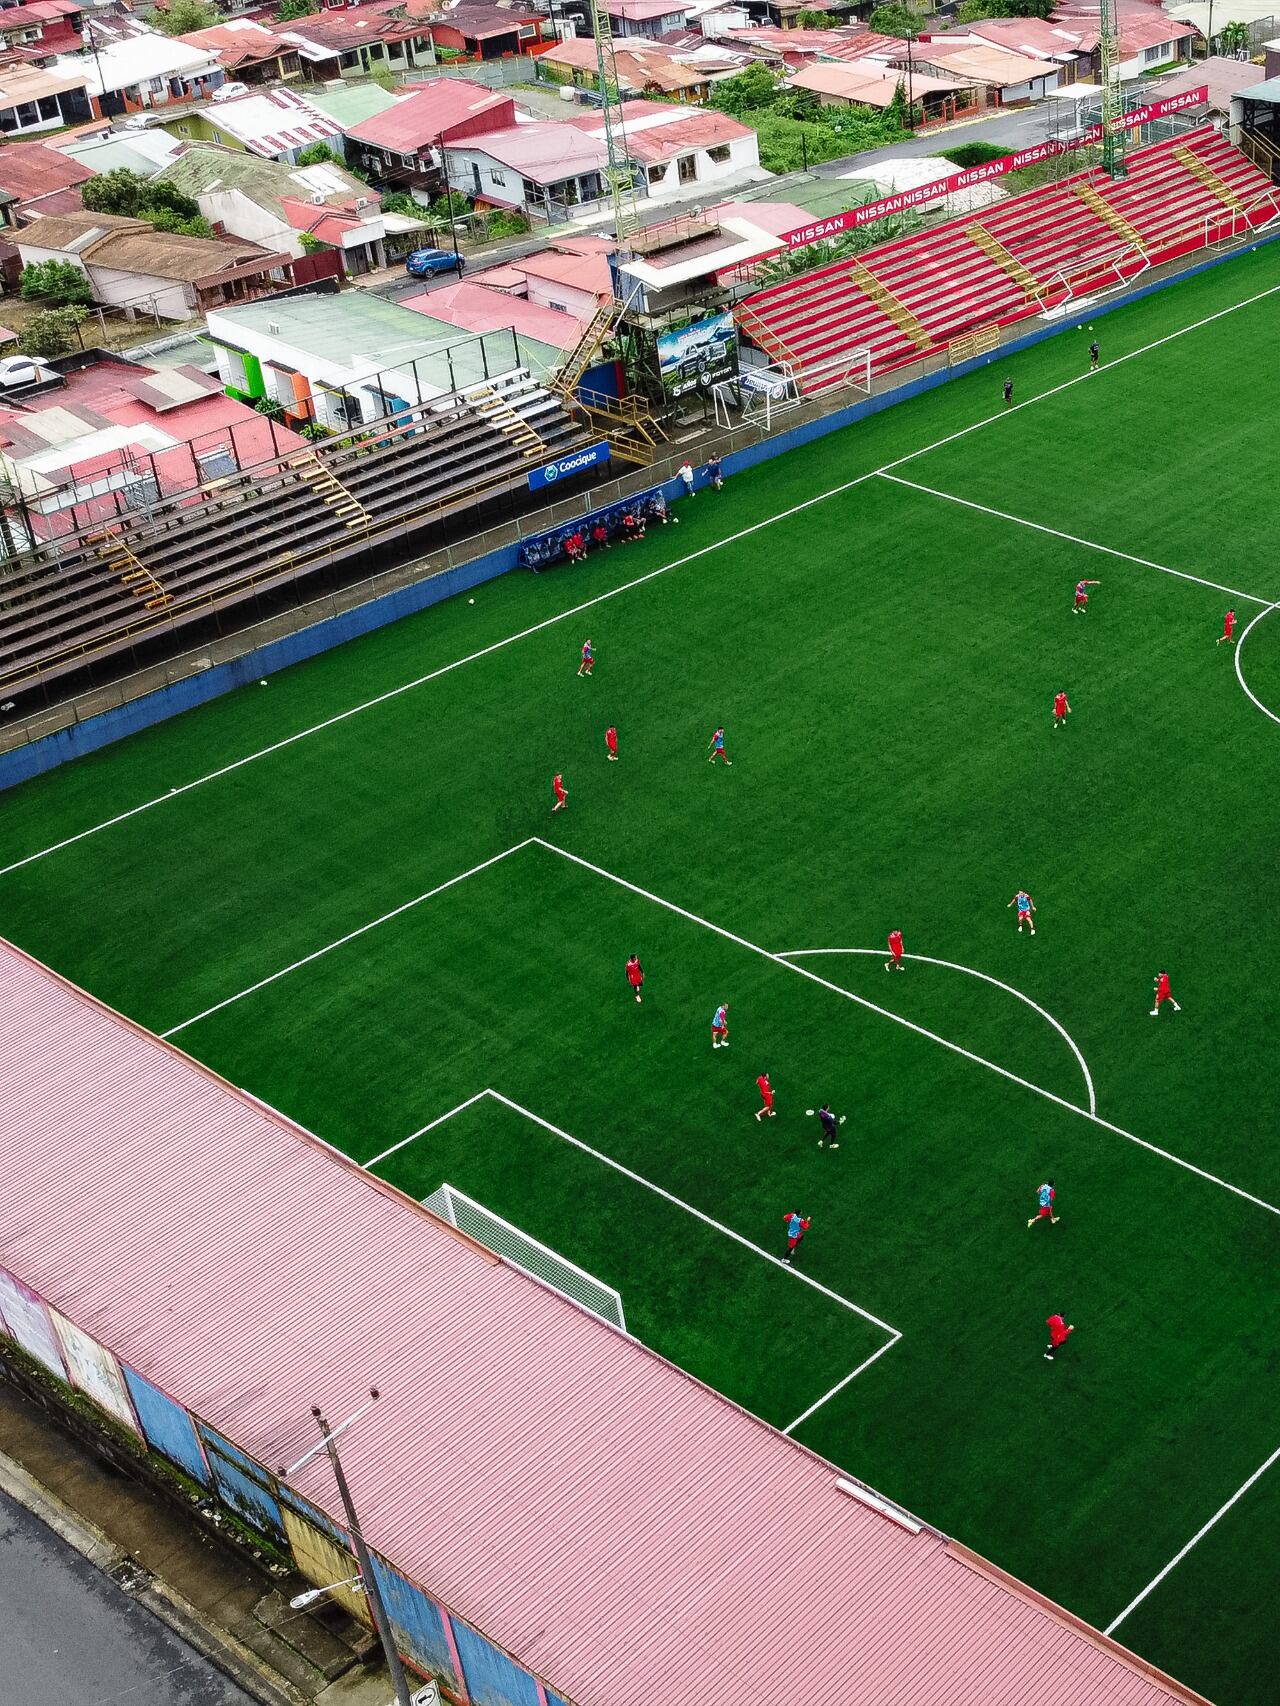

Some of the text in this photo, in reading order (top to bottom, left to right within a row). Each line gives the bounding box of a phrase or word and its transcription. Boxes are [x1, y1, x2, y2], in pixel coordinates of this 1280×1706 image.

[1160, 92, 1200, 114] NISSAN
[1013, 142, 1056, 166] NISSAN
[957, 162, 1004, 187] NISSAN
[903, 181, 948, 206] NISSAN
[856, 198, 902, 223] NISSAN
[790, 217, 844, 246] NISSAN
[559, 451, 597, 473] Coocique
